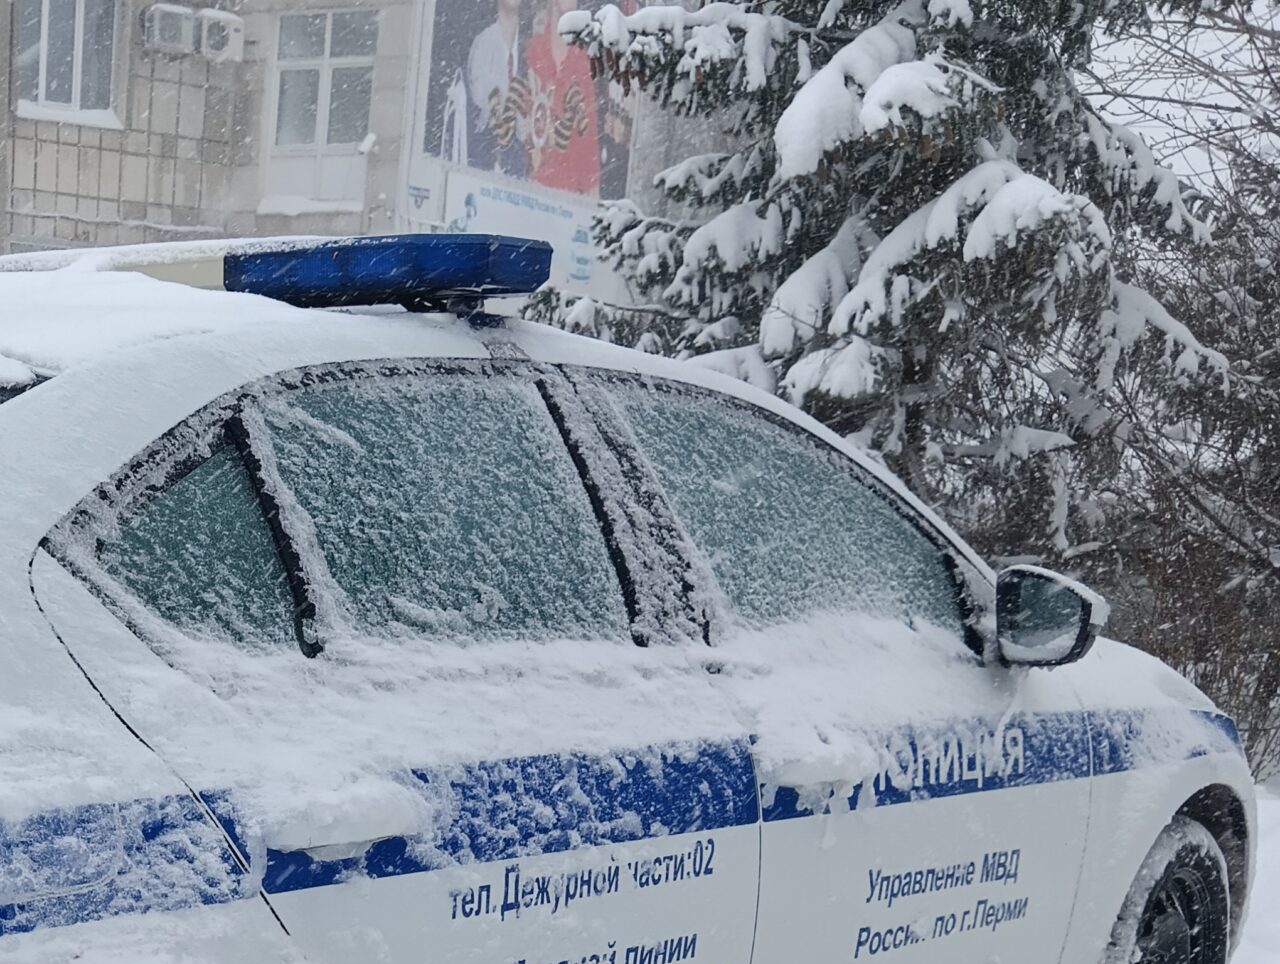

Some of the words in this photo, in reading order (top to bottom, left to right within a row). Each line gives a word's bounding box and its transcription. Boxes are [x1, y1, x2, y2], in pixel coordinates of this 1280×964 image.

[868, 727, 1024, 793] ОЛИЦИЯ
[866, 861, 976, 907] Управление
[980, 848, 1020, 886] МВД
[854, 923, 926, 959] Росси
[932, 912, 957, 940] по
